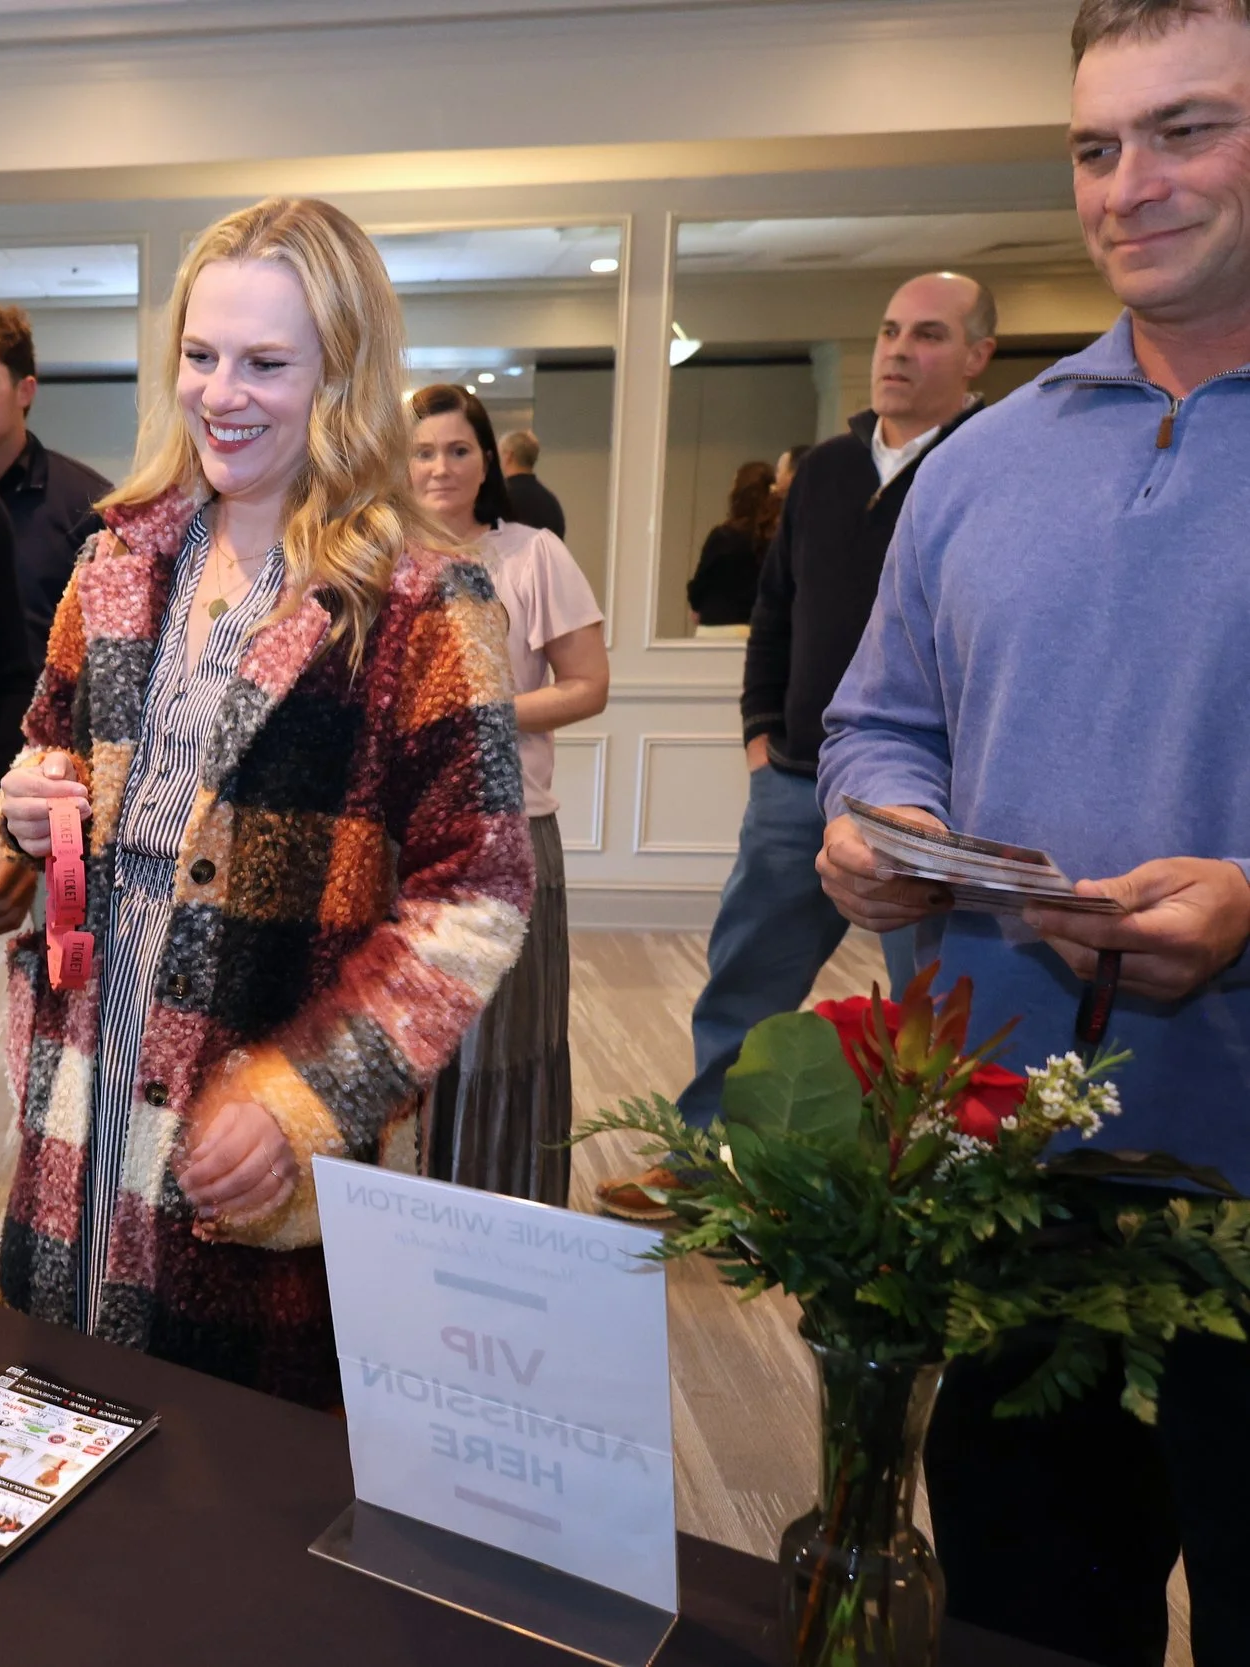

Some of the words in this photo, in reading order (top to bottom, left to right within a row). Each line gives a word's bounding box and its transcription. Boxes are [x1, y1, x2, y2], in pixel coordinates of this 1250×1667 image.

[60, 814, 73, 845] TICKET
[64, 868, 77, 902] TICKET
[70, 942, 85, 974] TICKET
[15, 1383, 63, 1403] ACHIEVEMENT
[68, 1401, 91, 1412] DRIVE
[97, 1409, 143, 1426] EXCELLENCE
